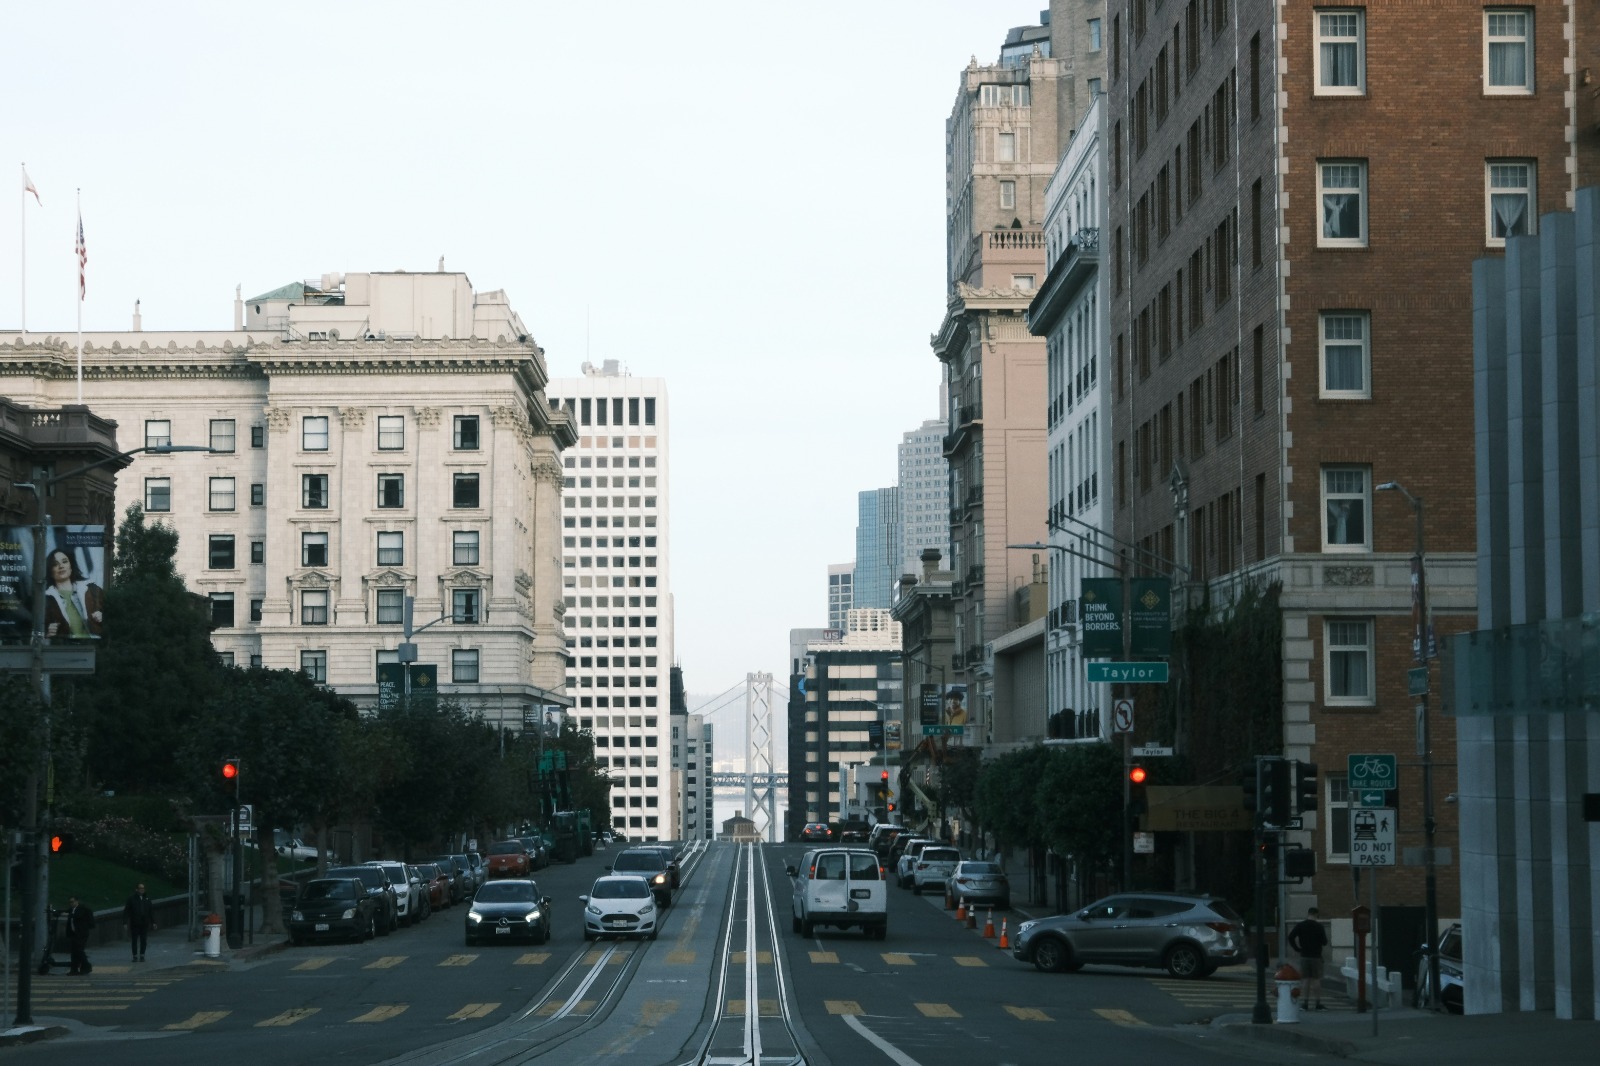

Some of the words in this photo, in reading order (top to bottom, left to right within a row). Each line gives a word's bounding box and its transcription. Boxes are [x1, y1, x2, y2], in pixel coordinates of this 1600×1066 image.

[2, 563, 27, 572] vision
[1085, 603, 1108, 612] THINK
[1086, 613, 1115, 622] BEYOND
[1086, 622, 1121, 631] BORDERS.
[1102, 667, 1154, 680] Taylor
[1353, 779, 1368, 788] BIKE
[1370, 779, 1392, 788] ROUTE
[1174, 809, 1200, 819] THE
[1205, 809, 1227, 819] BIG
[1354, 842, 1368, 852] DO
[1372, 842, 1392, 852] NOT
[1360, 854, 1387, 864] PASS
